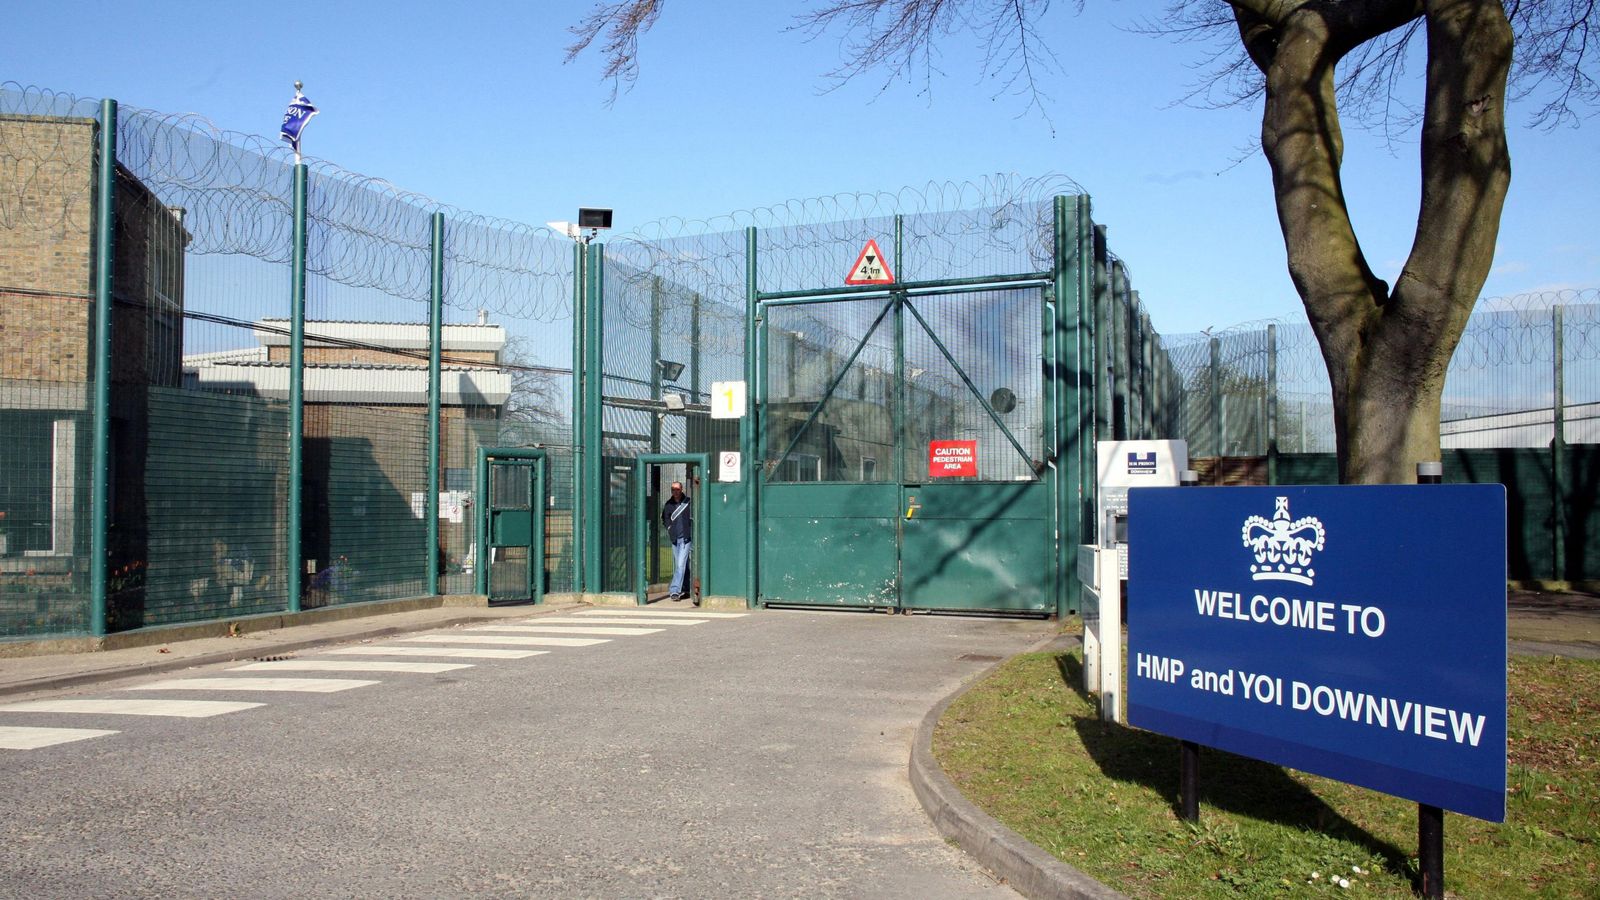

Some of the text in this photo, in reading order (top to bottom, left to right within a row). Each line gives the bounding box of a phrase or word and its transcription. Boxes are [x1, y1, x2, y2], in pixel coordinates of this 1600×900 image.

[723, 388, 733, 412] 1
[1194, 589, 1386, 638] WELCOME TO
[1137, 652, 1486, 747] HMP and YOI DOWNVIEW
